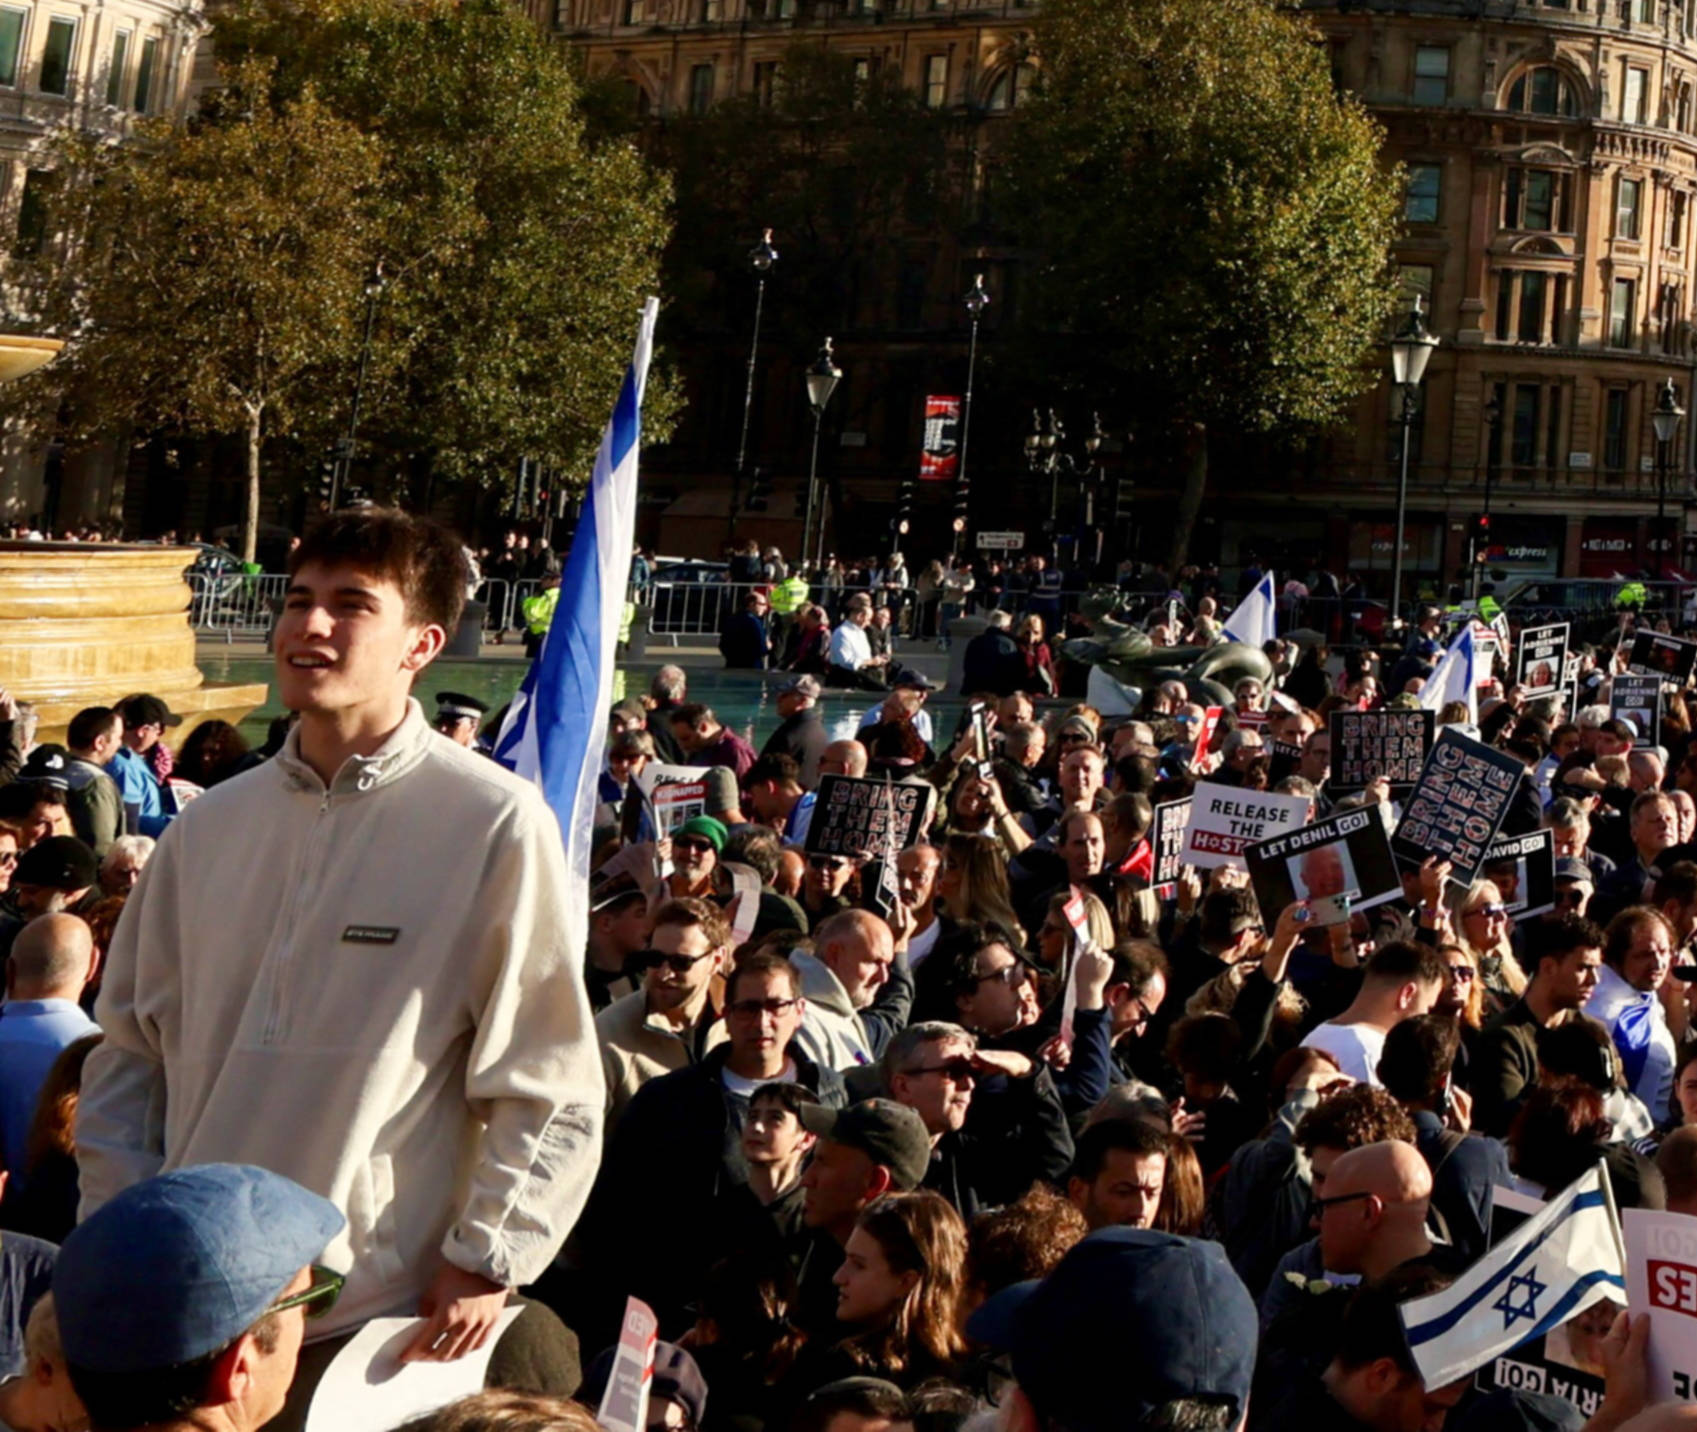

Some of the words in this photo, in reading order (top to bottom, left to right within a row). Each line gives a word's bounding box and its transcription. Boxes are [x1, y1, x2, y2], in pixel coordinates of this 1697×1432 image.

[1538, 629, 1552, 639] LET
[1614, 687, 1657, 696] ADRIENNE
[1627, 678, 1643, 687] LET
[1343, 713, 1425, 737] BRING
[1342, 737, 1423, 760] THEM
[1342, 760, 1422, 783] HOME
[832, 780, 919, 812] BRING
[1399, 742, 1465, 847] BRING
[1425, 756, 1489, 854] THEM
[826, 802, 912, 836] THEM
[1210, 799, 1290, 823] RELEASE
[1449, 765, 1515, 870] HOME
[1229, 819, 1265, 839] THE
[1259, 841, 1288, 860] LET
[1289, 827, 1337, 851] DENIL
[1340, 812, 1370, 833] GO!
[1501, 1361, 1542, 1389] GO!
[1552, 1379, 1605, 1415] RTA
